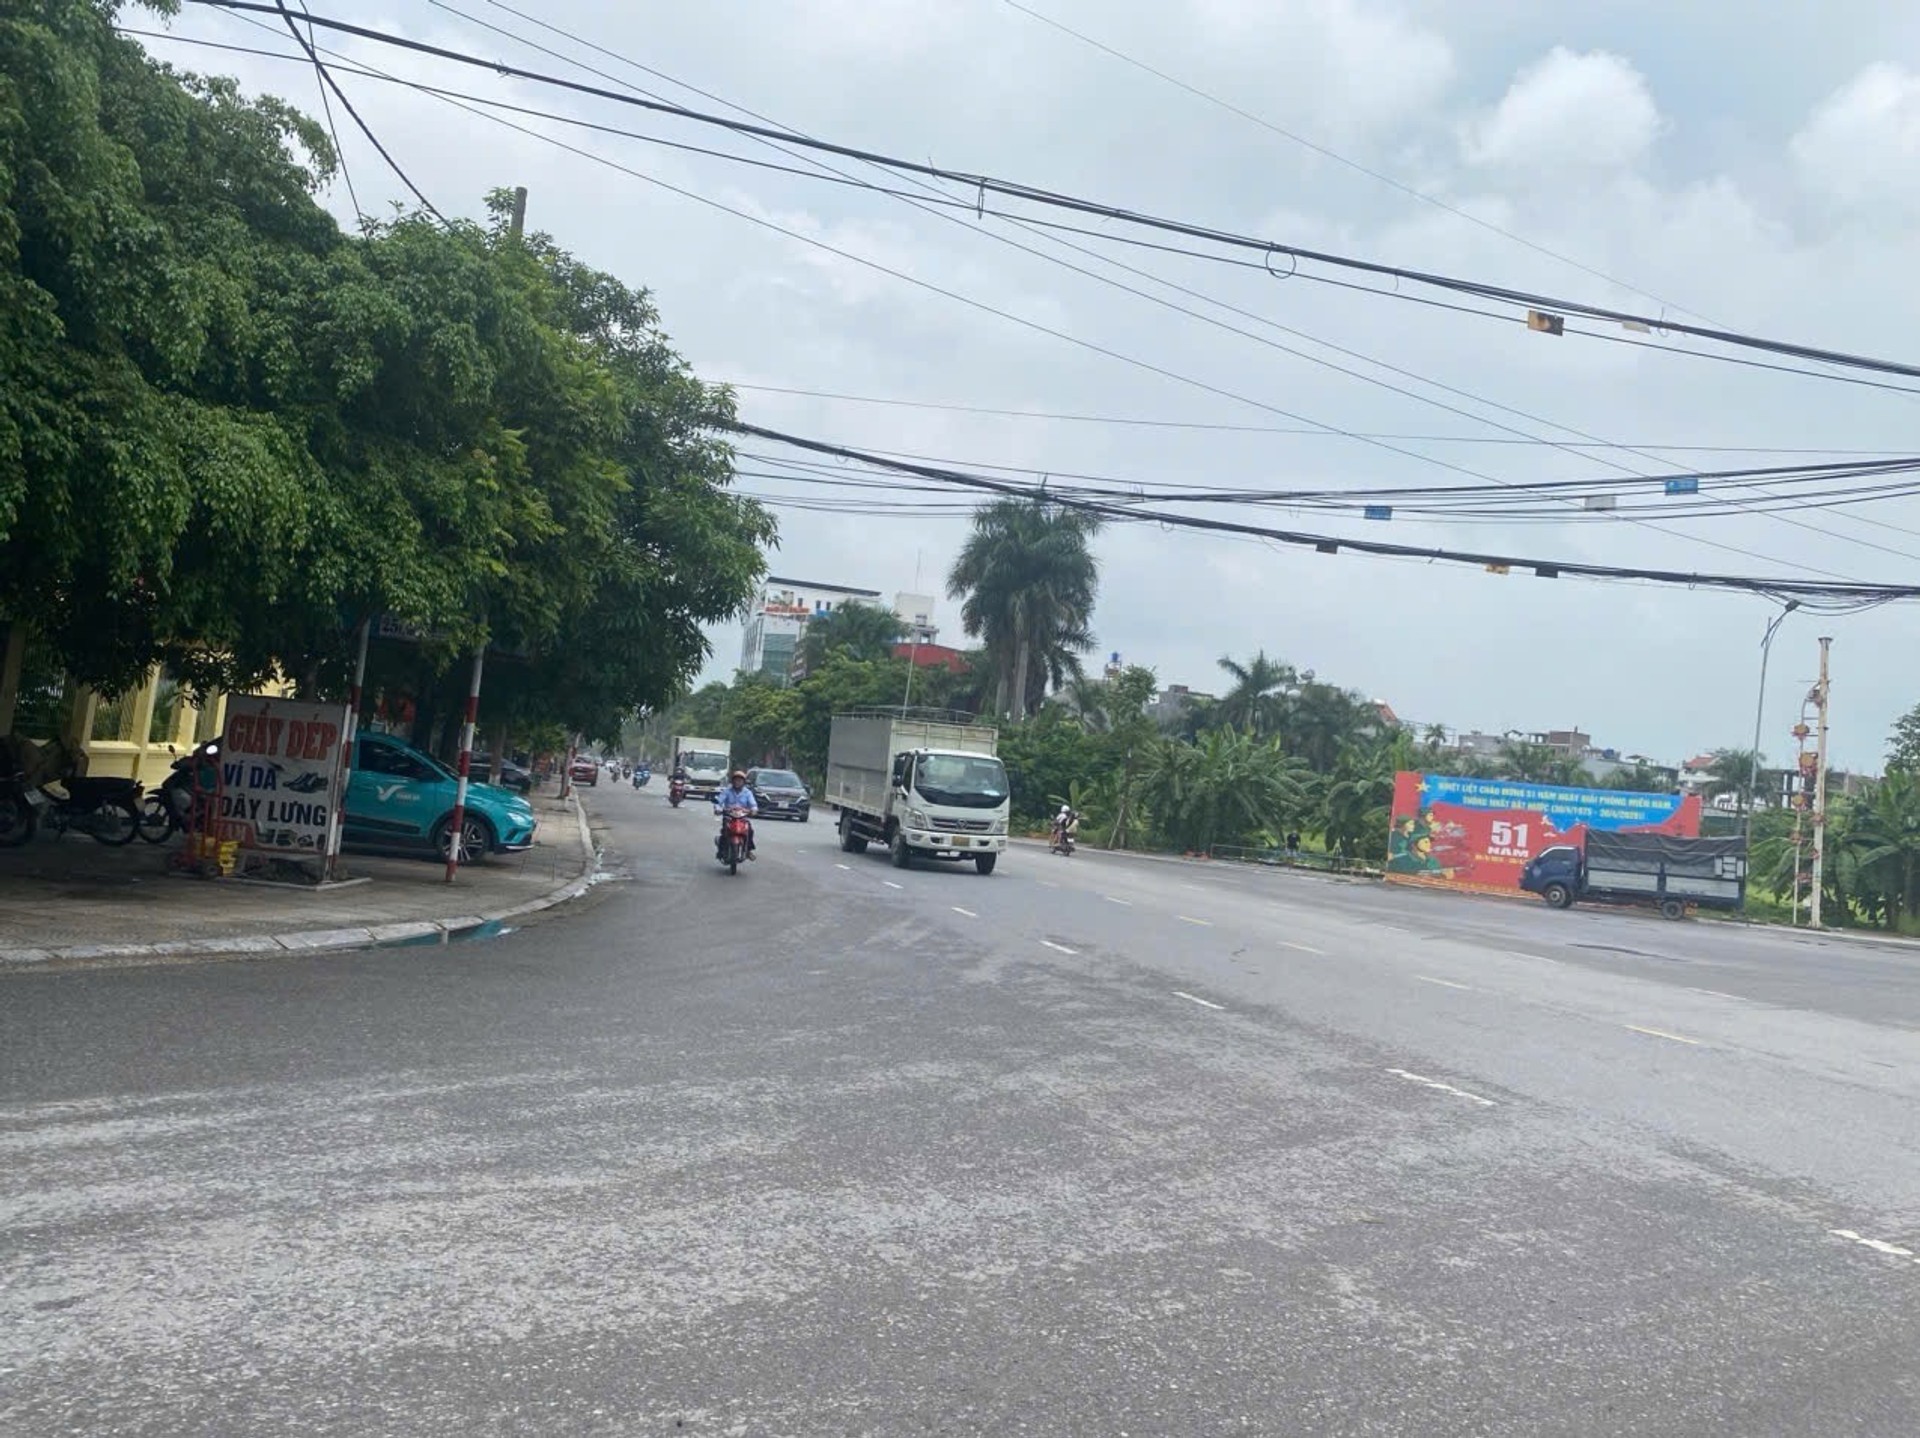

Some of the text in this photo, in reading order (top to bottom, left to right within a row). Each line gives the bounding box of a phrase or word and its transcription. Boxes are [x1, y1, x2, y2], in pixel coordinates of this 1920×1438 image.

[286, 713, 337, 761] DÉP
[224, 760, 277, 790] VÍ DA
[221, 793, 328, 828] DÂY LƯNG
[1491, 820, 1529, 848] 51
